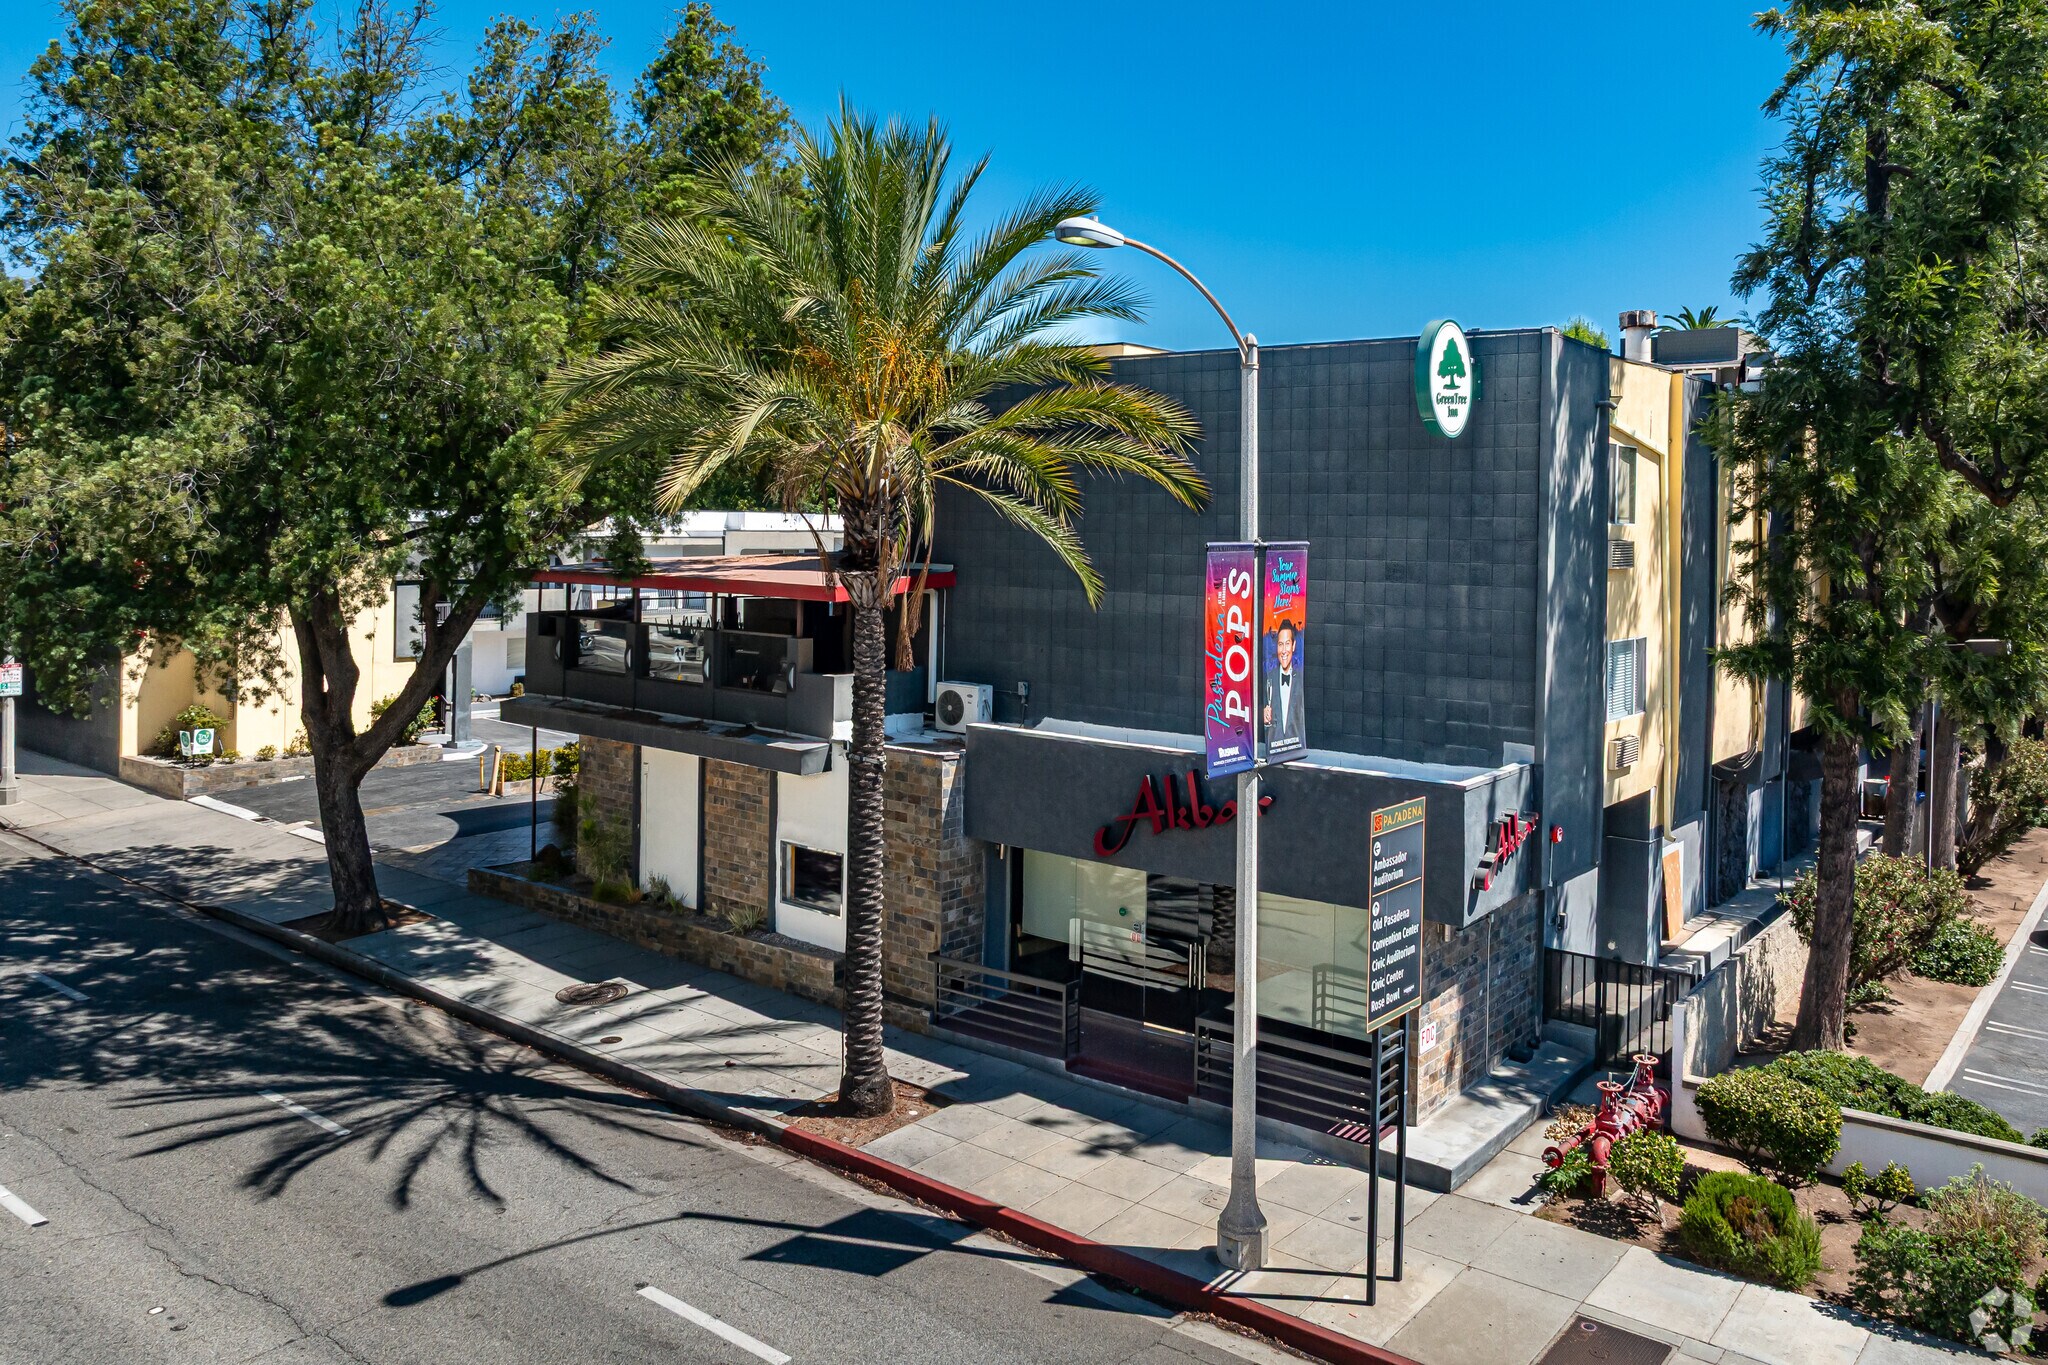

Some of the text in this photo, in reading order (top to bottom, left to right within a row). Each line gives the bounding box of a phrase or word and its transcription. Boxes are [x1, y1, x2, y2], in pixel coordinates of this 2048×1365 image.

[1436, 392, 1467, 405] GreenTree
[1447, 405, 1458, 418] Inn
[1279, 557, 1293, 571] Your
[1274, 594, 1292, 608] Here!
[1225, 568, 1250, 723] POPS
[1205, 605, 1230, 740] Pasadena
[1383, 805, 1423, 827] PASADENA
[1373, 851, 1408, 872] Ambassador
[1373, 868, 1404, 888] Auditorium
[1372, 908, 1410, 932] Old Pasadena
[1372, 923, 1420, 952] Convention Center
[1371, 944, 1416, 972] Civic Auditorium
[1371, 976, 1386, 992] Civic
[1386, 968, 1404, 985] Center
[1370, 998, 1385, 1013] Rose
[1386, 988, 1400, 1005] Bowl
[1421, 1025, 1435, 1046] FDC
